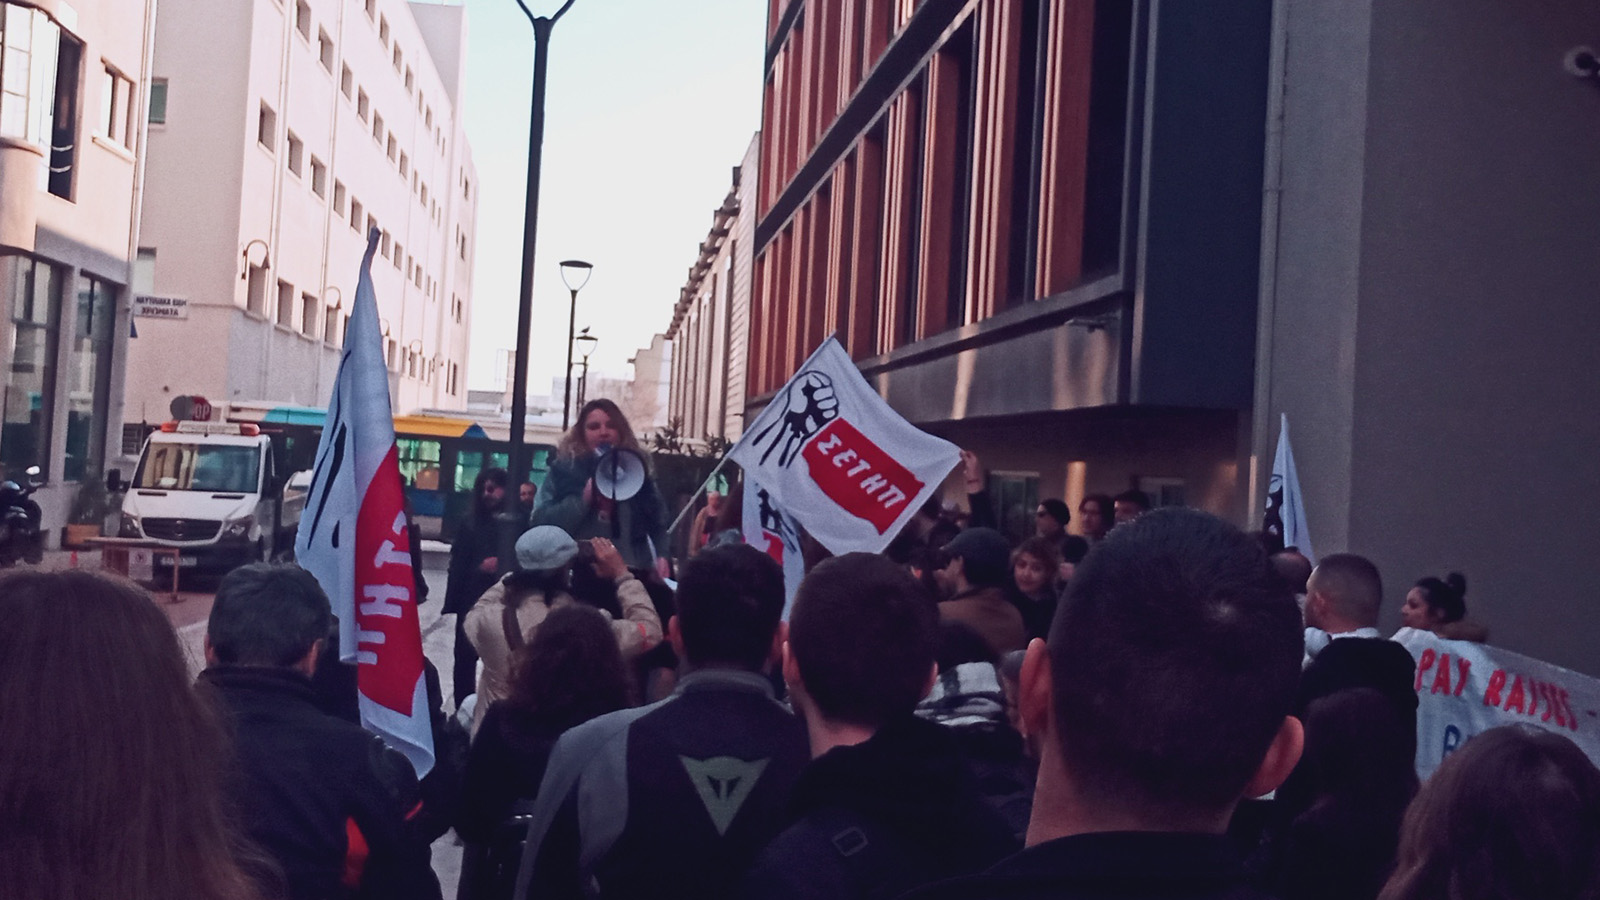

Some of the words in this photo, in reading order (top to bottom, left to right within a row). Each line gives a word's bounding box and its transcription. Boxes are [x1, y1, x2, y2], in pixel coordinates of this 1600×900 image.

[193, 403, 210, 420] OP
[817, 433, 906, 509] ΣΕΤΗΠ
[1414, 648, 1472, 697] PAY
